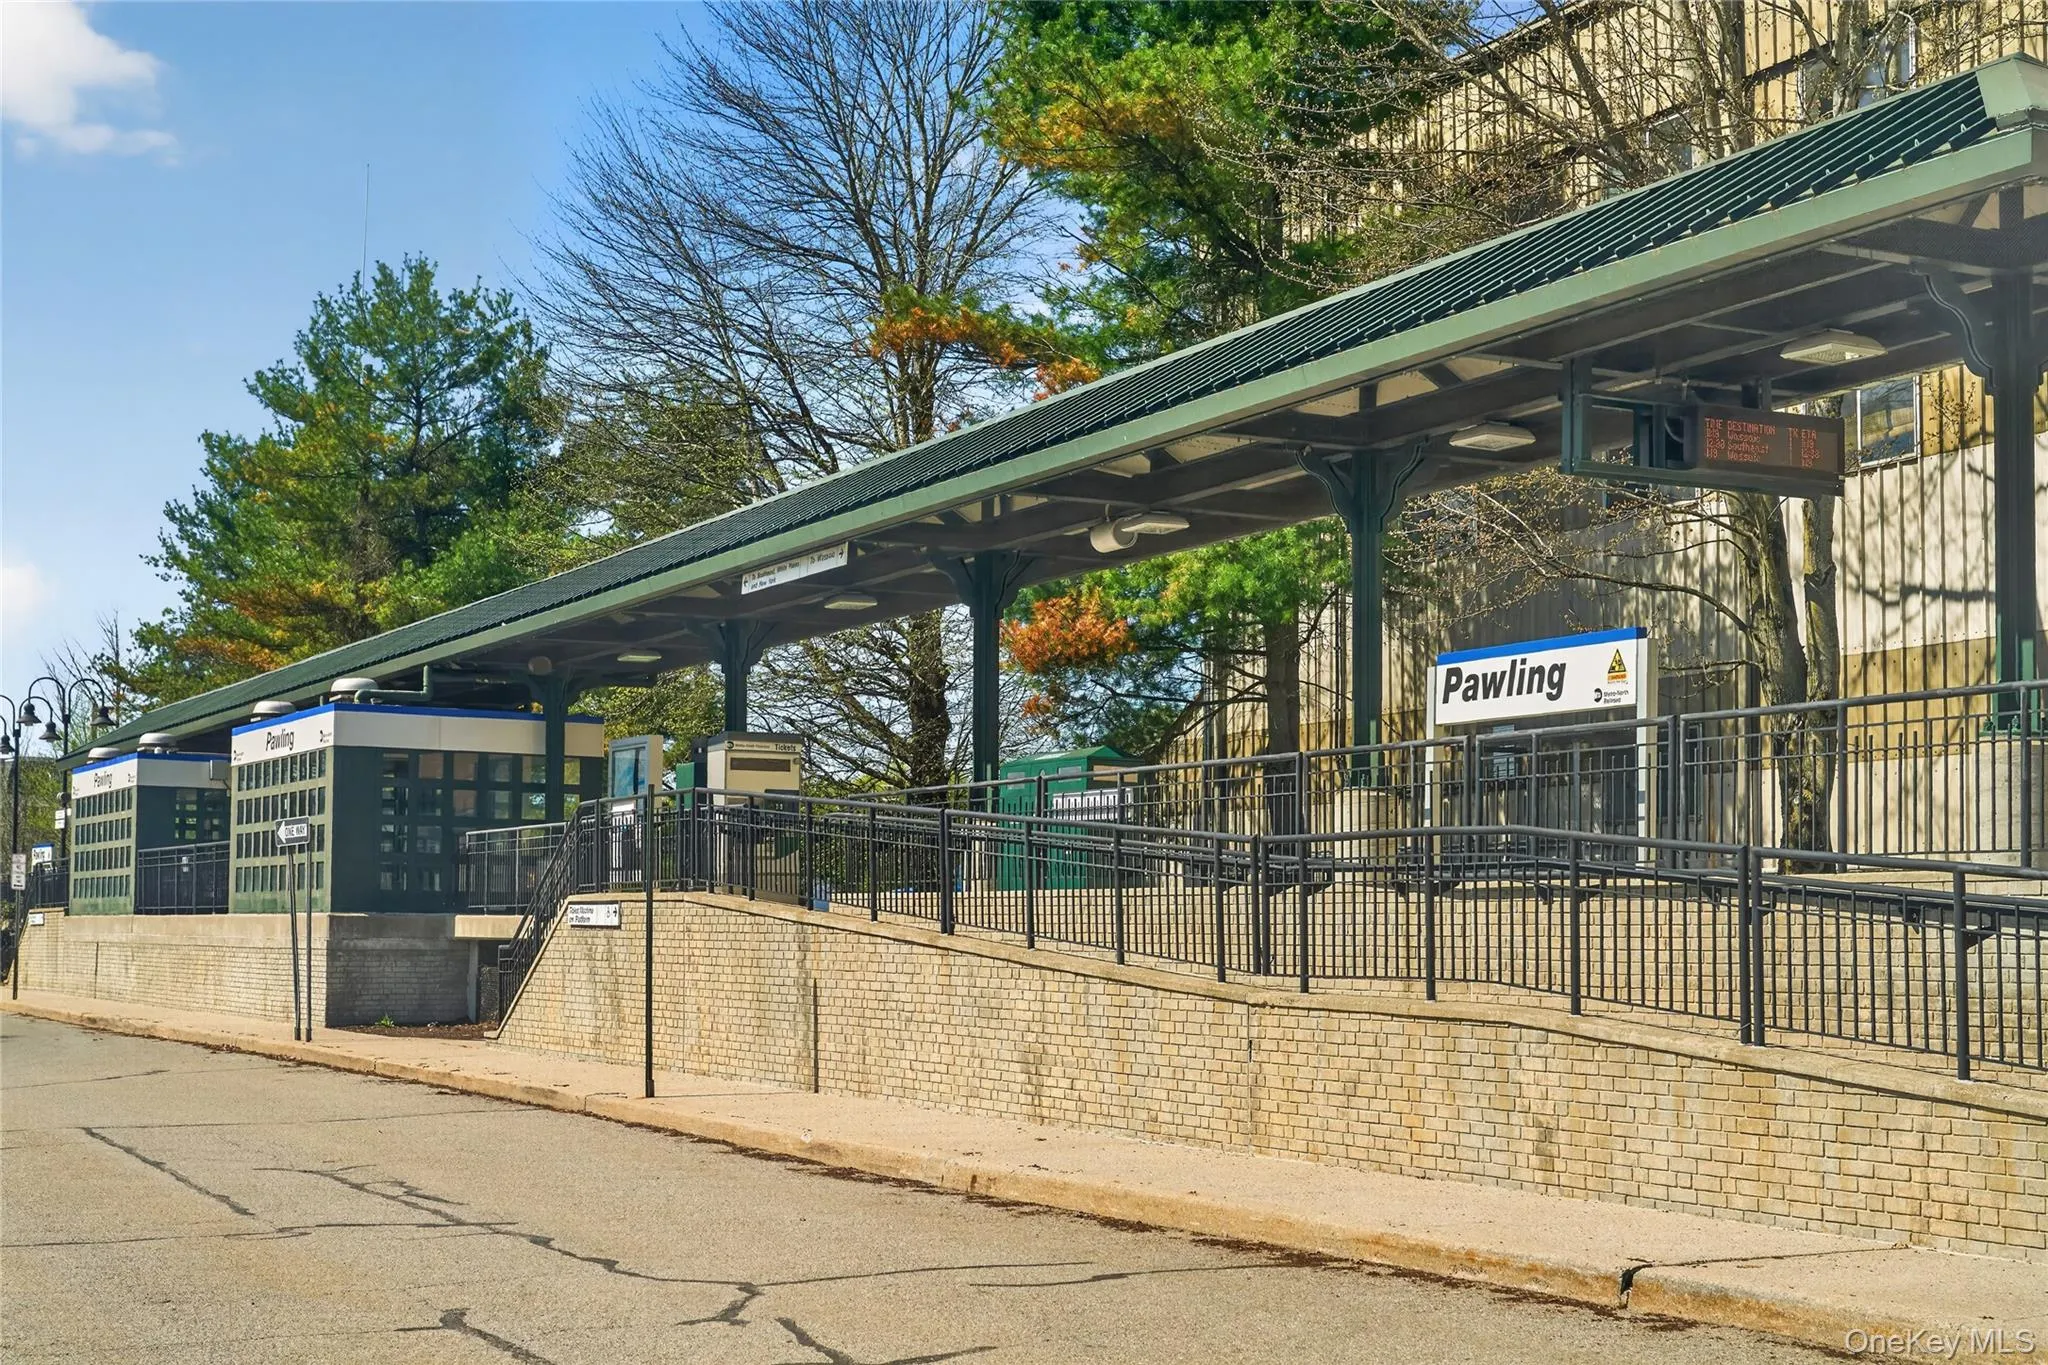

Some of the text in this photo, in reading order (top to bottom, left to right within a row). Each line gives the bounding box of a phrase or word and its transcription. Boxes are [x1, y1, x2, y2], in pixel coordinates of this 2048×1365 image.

[1727, 420, 1776, 436] DESTINATION
[1442, 658, 1567, 704] Pawling
[266, 728, 295, 751] Pawling
[774, 743, 797, 752] Tickets
[94, 771, 112, 788] Pawling
[285, 824, 306, 837] ONE WAY
